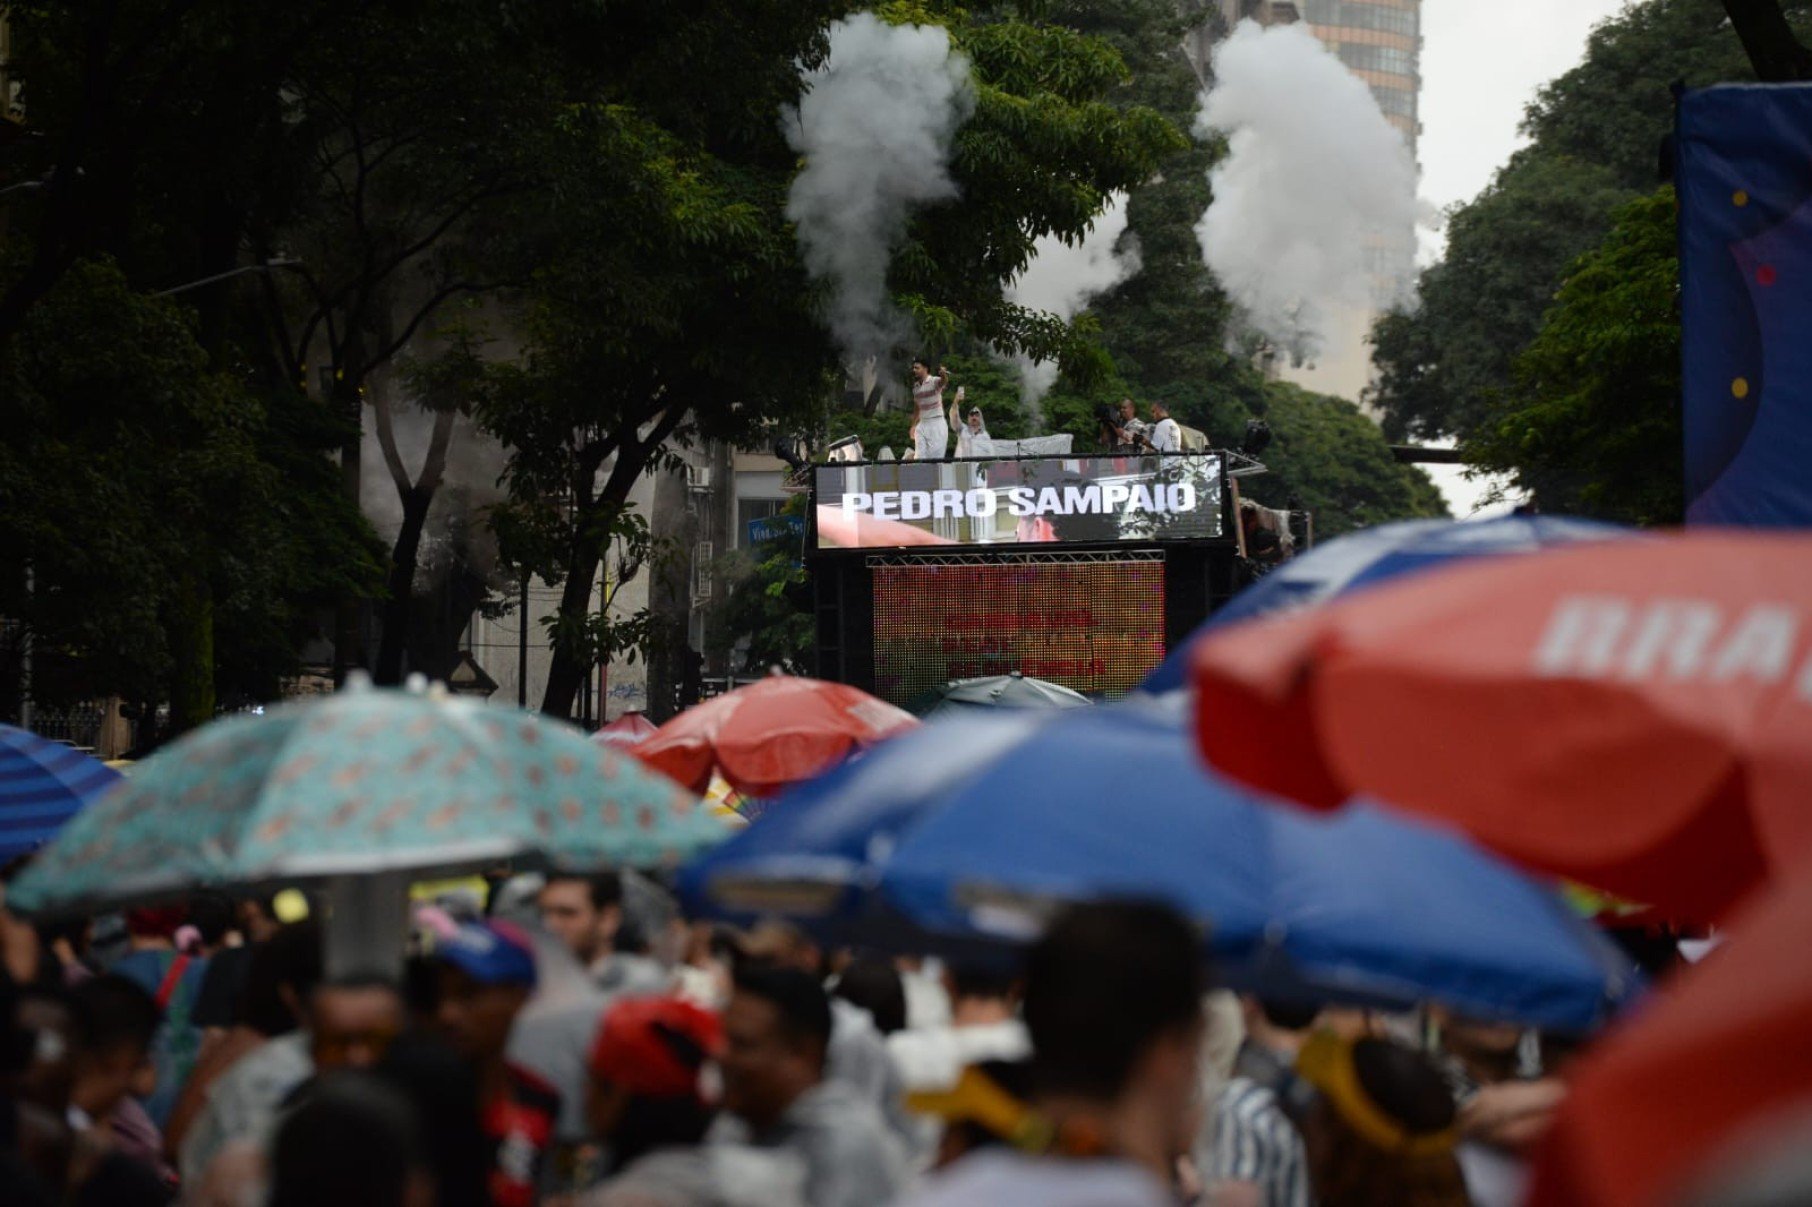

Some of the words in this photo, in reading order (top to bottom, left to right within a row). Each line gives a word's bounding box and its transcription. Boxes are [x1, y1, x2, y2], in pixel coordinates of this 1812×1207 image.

[842, 488, 997, 521] PEDRO
[1008, 483, 1196, 516] SAMPAIO
[1534, 595, 1812, 701] BRA
